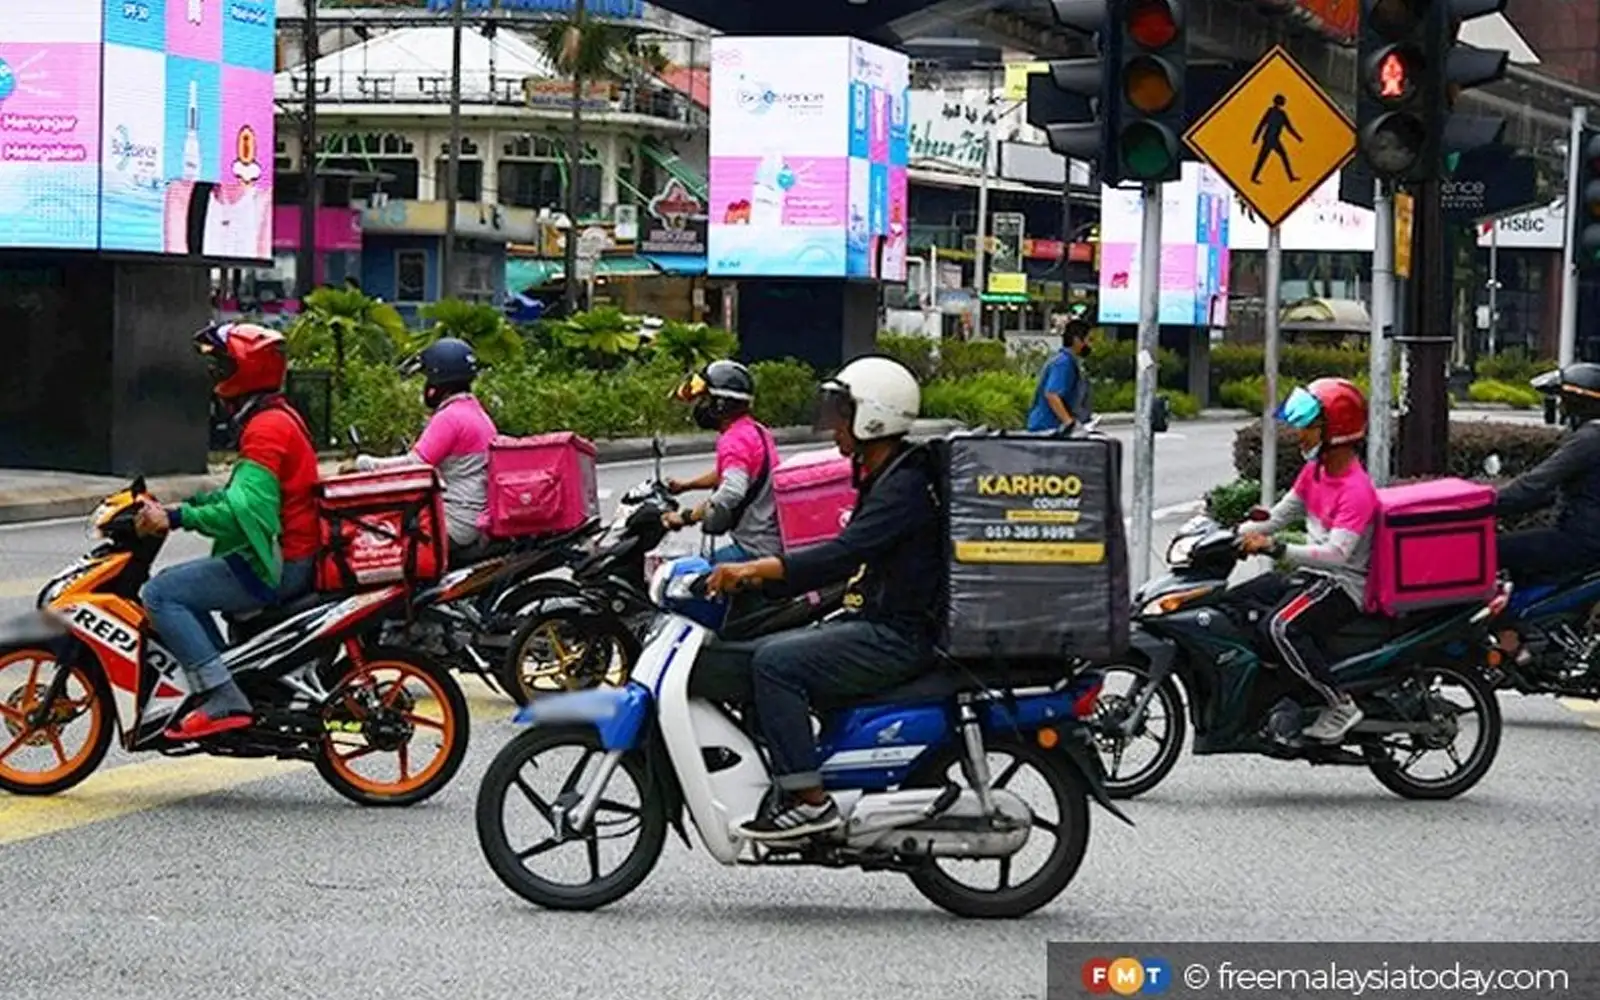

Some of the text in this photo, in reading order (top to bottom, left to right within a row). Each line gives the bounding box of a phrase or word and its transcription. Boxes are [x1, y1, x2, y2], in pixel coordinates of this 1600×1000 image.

[1500, 218, 1544, 232] HSBC
[977, 474, 1082, 496] KARHOO
[1032, 497, 1081, 509] courier
